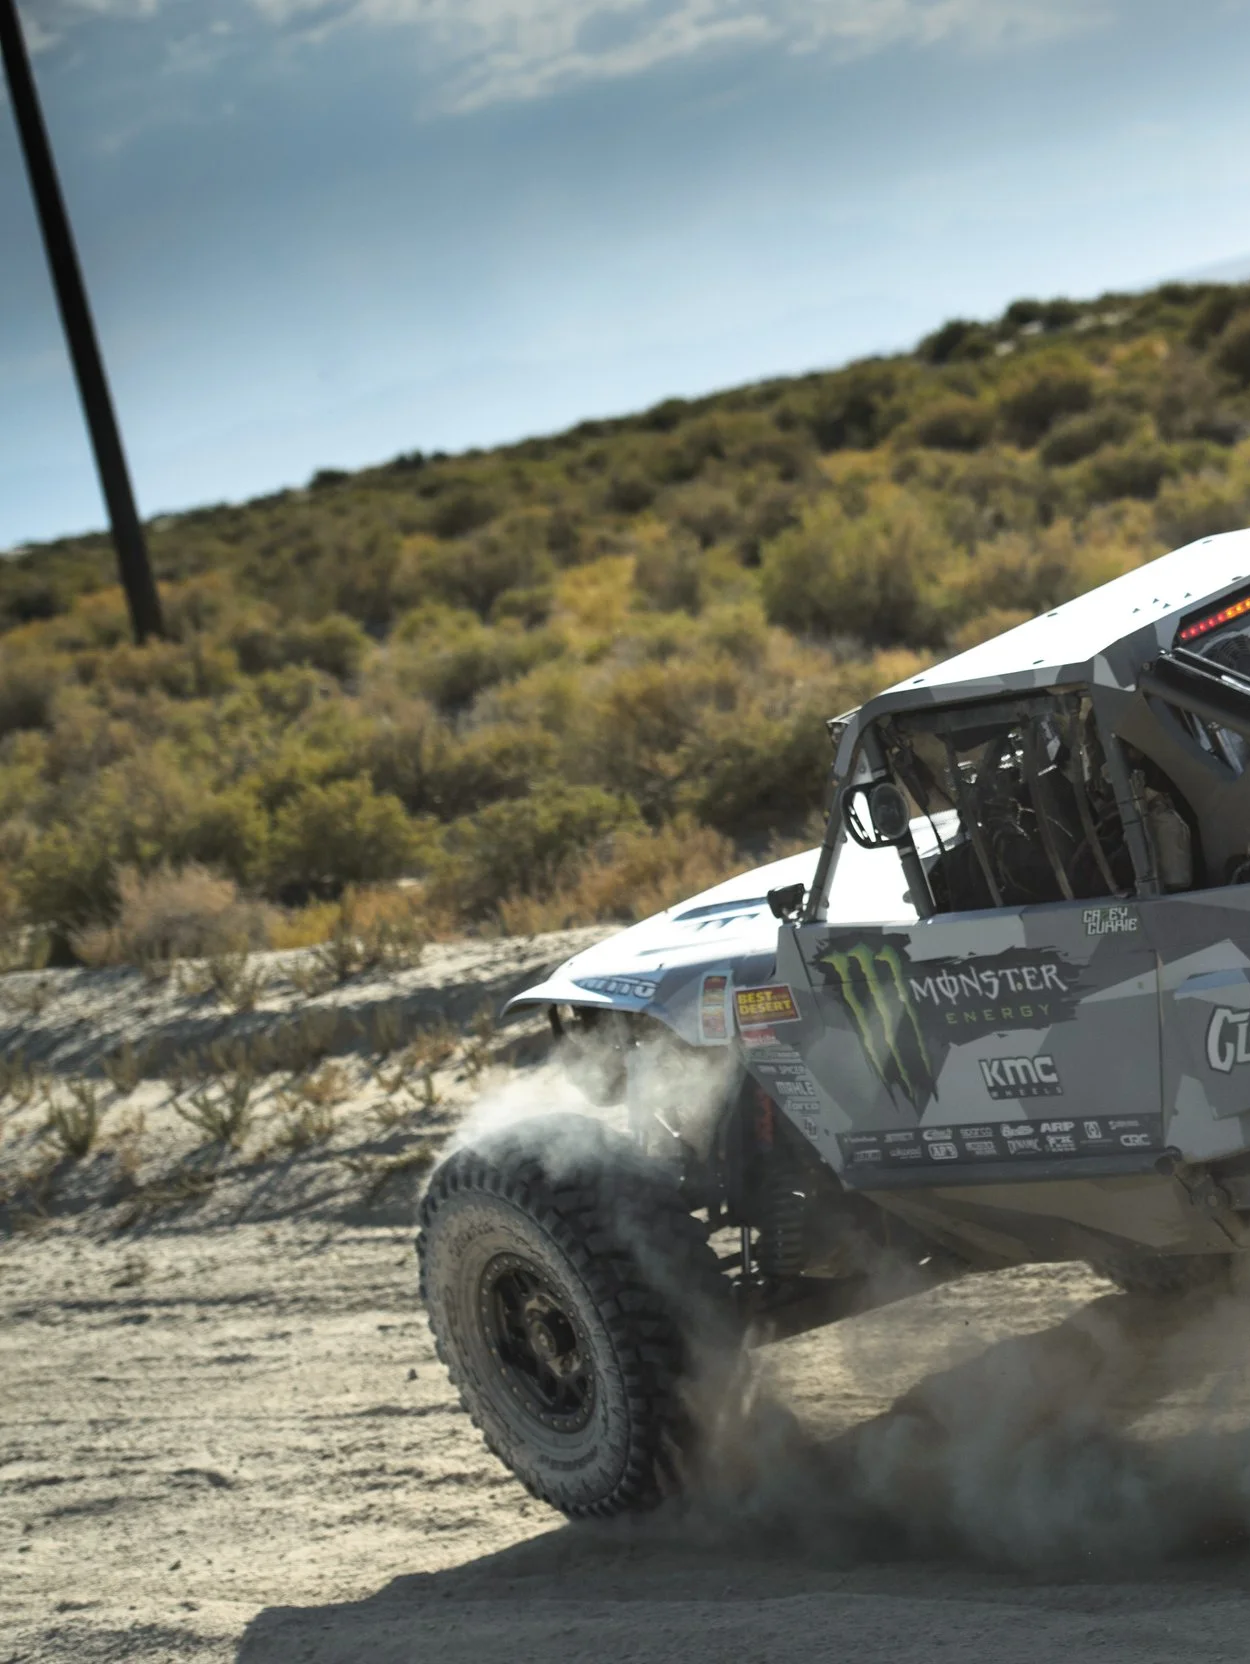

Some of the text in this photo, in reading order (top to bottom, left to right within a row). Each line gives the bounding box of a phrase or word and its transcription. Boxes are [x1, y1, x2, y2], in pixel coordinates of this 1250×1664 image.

[909, 963, 1069, 1005] MONSTER
[737, 991, 773, 1005] BEST
[739, 1000, 792, 1016] DESERT
[944, 1003, 1051, 1026] ENERGY
[980, 1056, 1059, 1087] KMC
[1040, 1120, 1075, 1134] ARP
[1119, 1133, 1152, 1148] CRC
